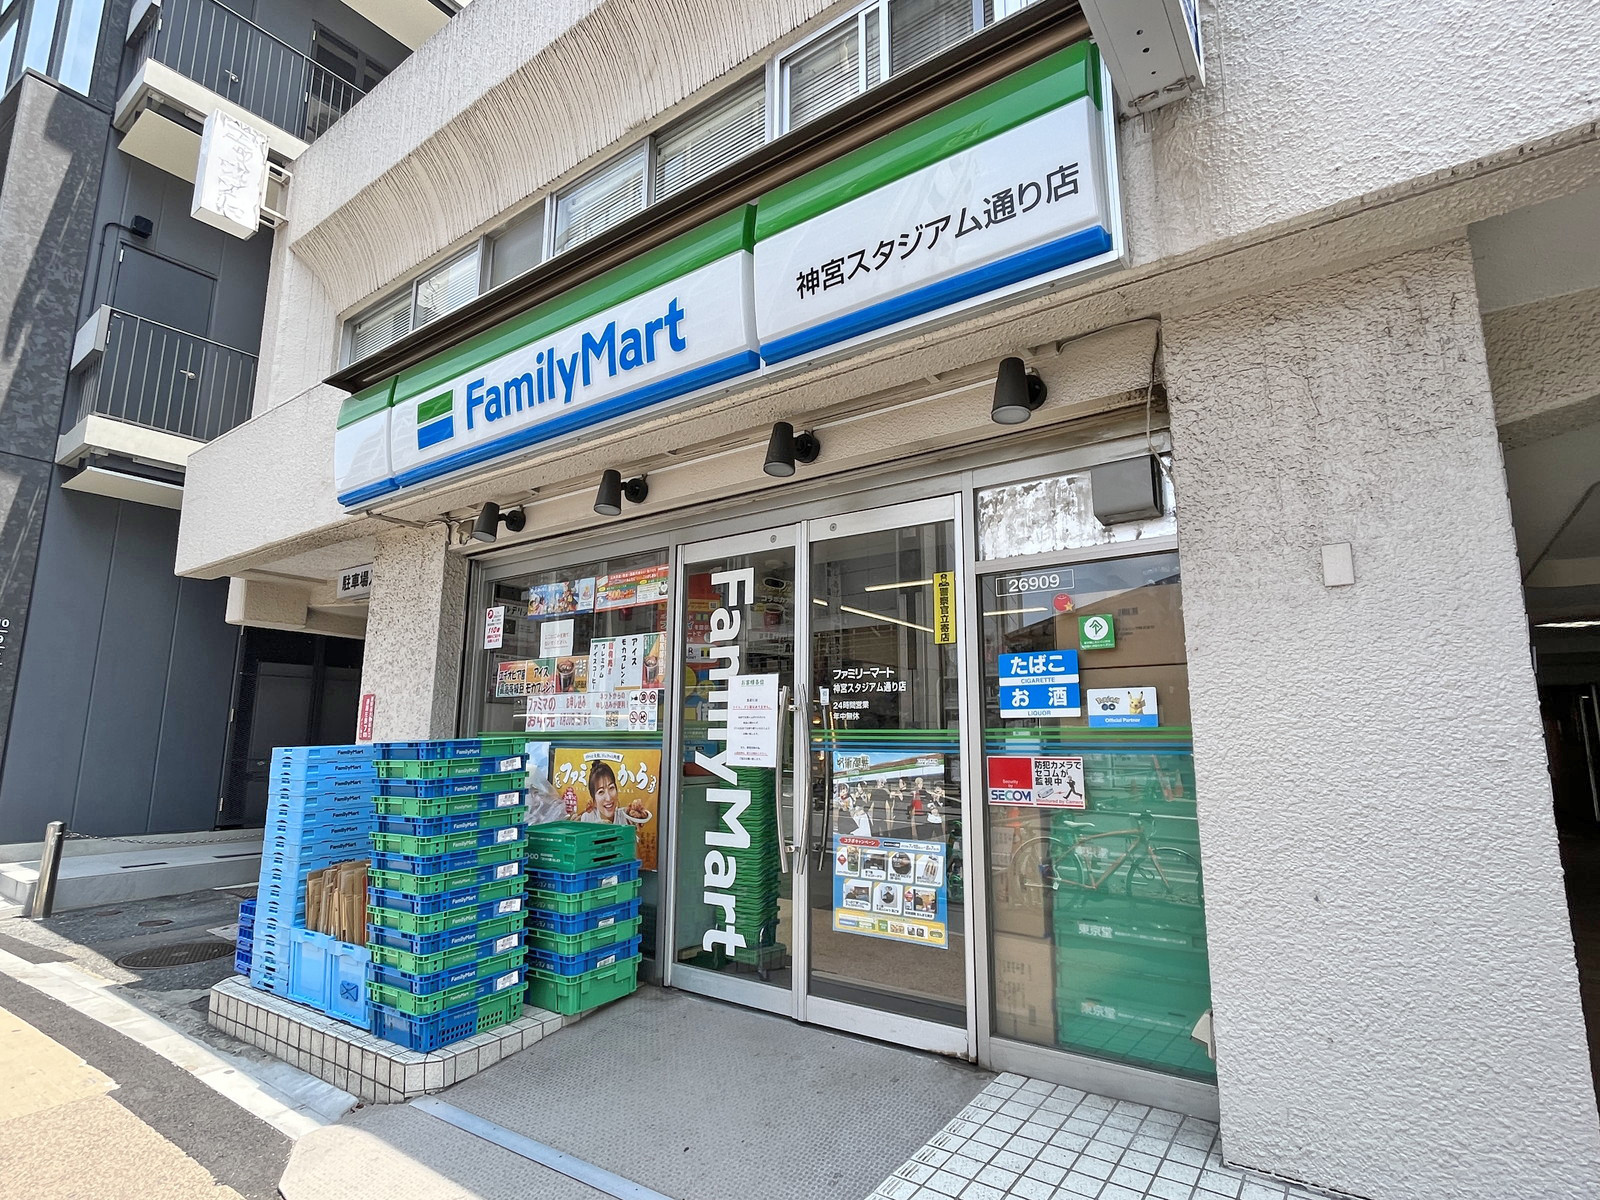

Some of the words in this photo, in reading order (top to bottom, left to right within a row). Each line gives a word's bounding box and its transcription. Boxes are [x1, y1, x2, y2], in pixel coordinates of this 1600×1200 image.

[796, 162, 1079, 299] 神宮スタジアム通り店
[466, 297, 686, 430] FamilyMart
[342, 569, 373, 591] 駐車場
[1008, 574, 1060, 592] 26909
[1010, 654, 1065, 675] たばこ
[832, 666, 895, 680] ファミリーマート
[833, 681, 907, 694] 神宮スタジアム通り店
[832, 701, 870, 710] 24時間営業
[833, 712, 860, 721] 年中無休
[1034, 761, 1081, 769] 防犯カメラで
[618, 762, 648, 790] から
[1034, 769, 1068, 778] セコムが
[1035, 777, 1062, 786] 監視中
[991, 790, 1031, 801] SECOM
[330, 826, 358, 834] FamilyMart
[453, 821, 478, 829] FamilyMart
[329, 842, 357, 850] FamilyMart
[452, 895, 477, 904] FamilyMart
[451, 933, 476, 944] FamilyMart
[450, 971, 476, 982] FamilyMart
